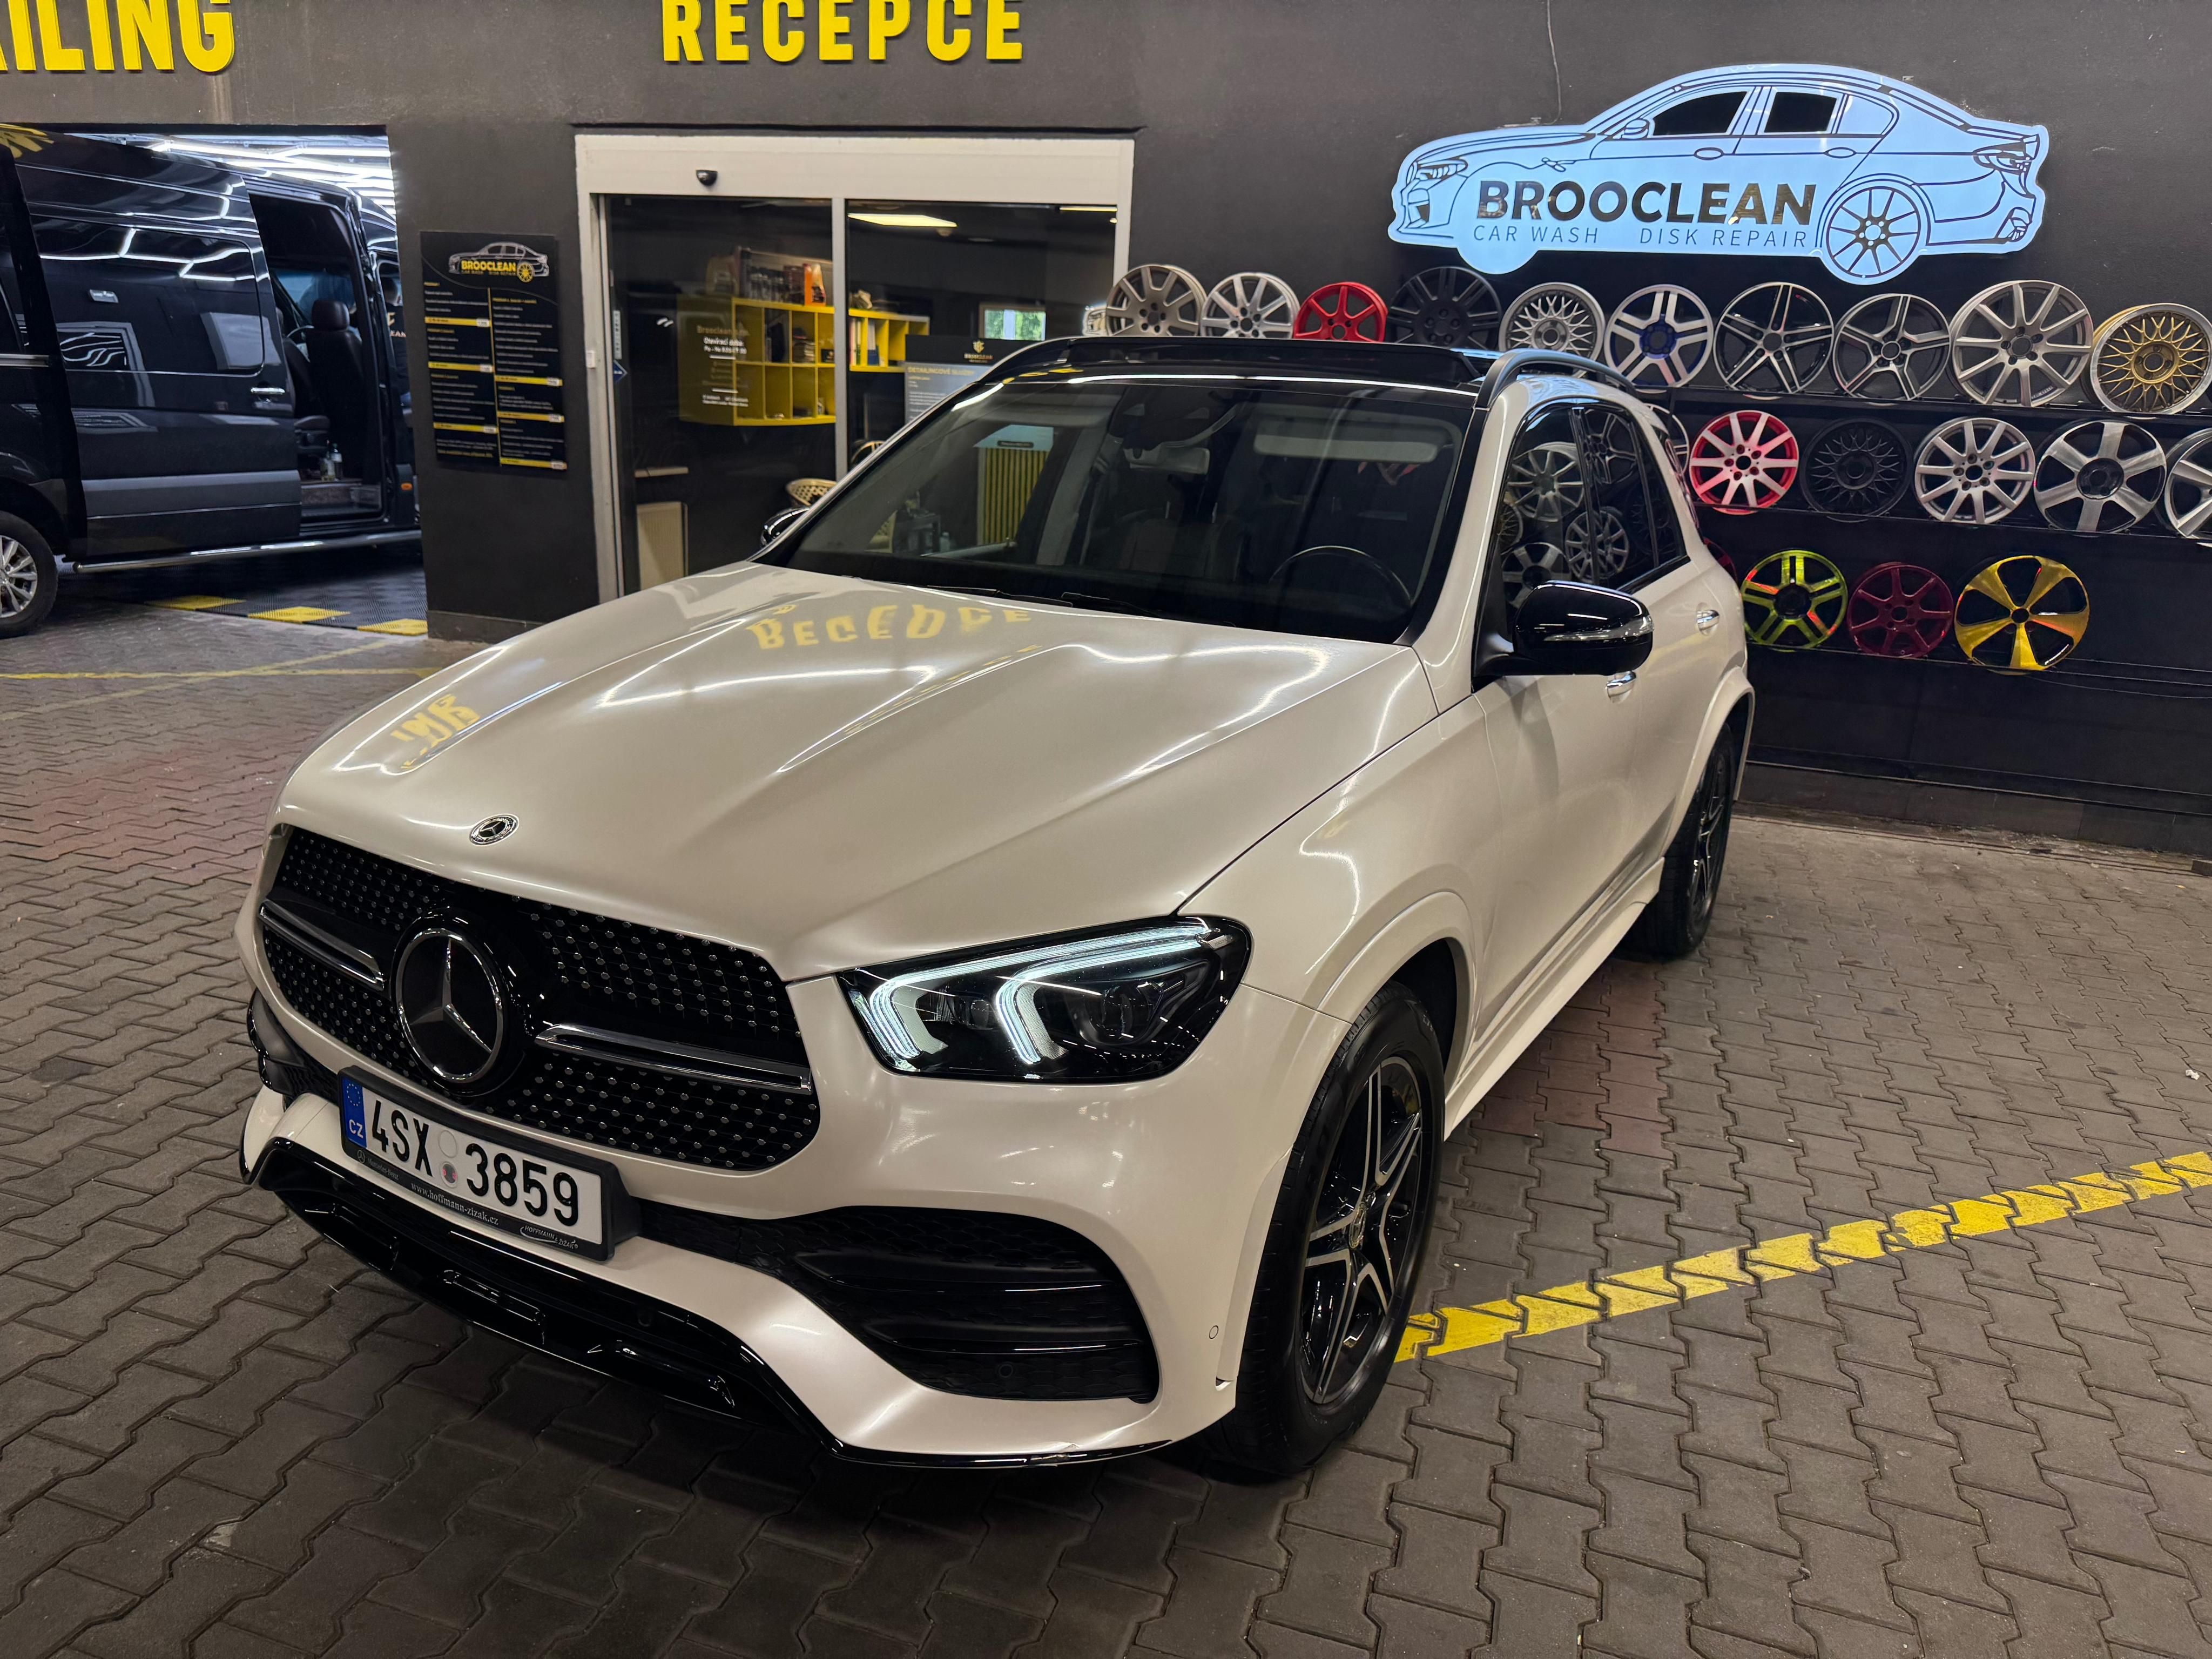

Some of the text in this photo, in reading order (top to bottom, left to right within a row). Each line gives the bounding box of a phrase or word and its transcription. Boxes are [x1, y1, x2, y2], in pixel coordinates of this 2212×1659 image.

[0, 0, 234, 72] ILING
[663, 0, 1022, 62] RECEPCE
[1476, 180, 1817, 225] BROOCLEAN
[1474, 225, 1806, 248] CAR WASH DISK REPAIR
[461, 260, 517, 272] BROOCLEAN
[349, 1119, 363, 1138] CZ
[372, 1100, 579, 1226] 4SX 3859
[410, 1181, 500, 1226] www.hoffmann-zizak.cz
[524, 1225, 555, 1240] HOFFMANN
